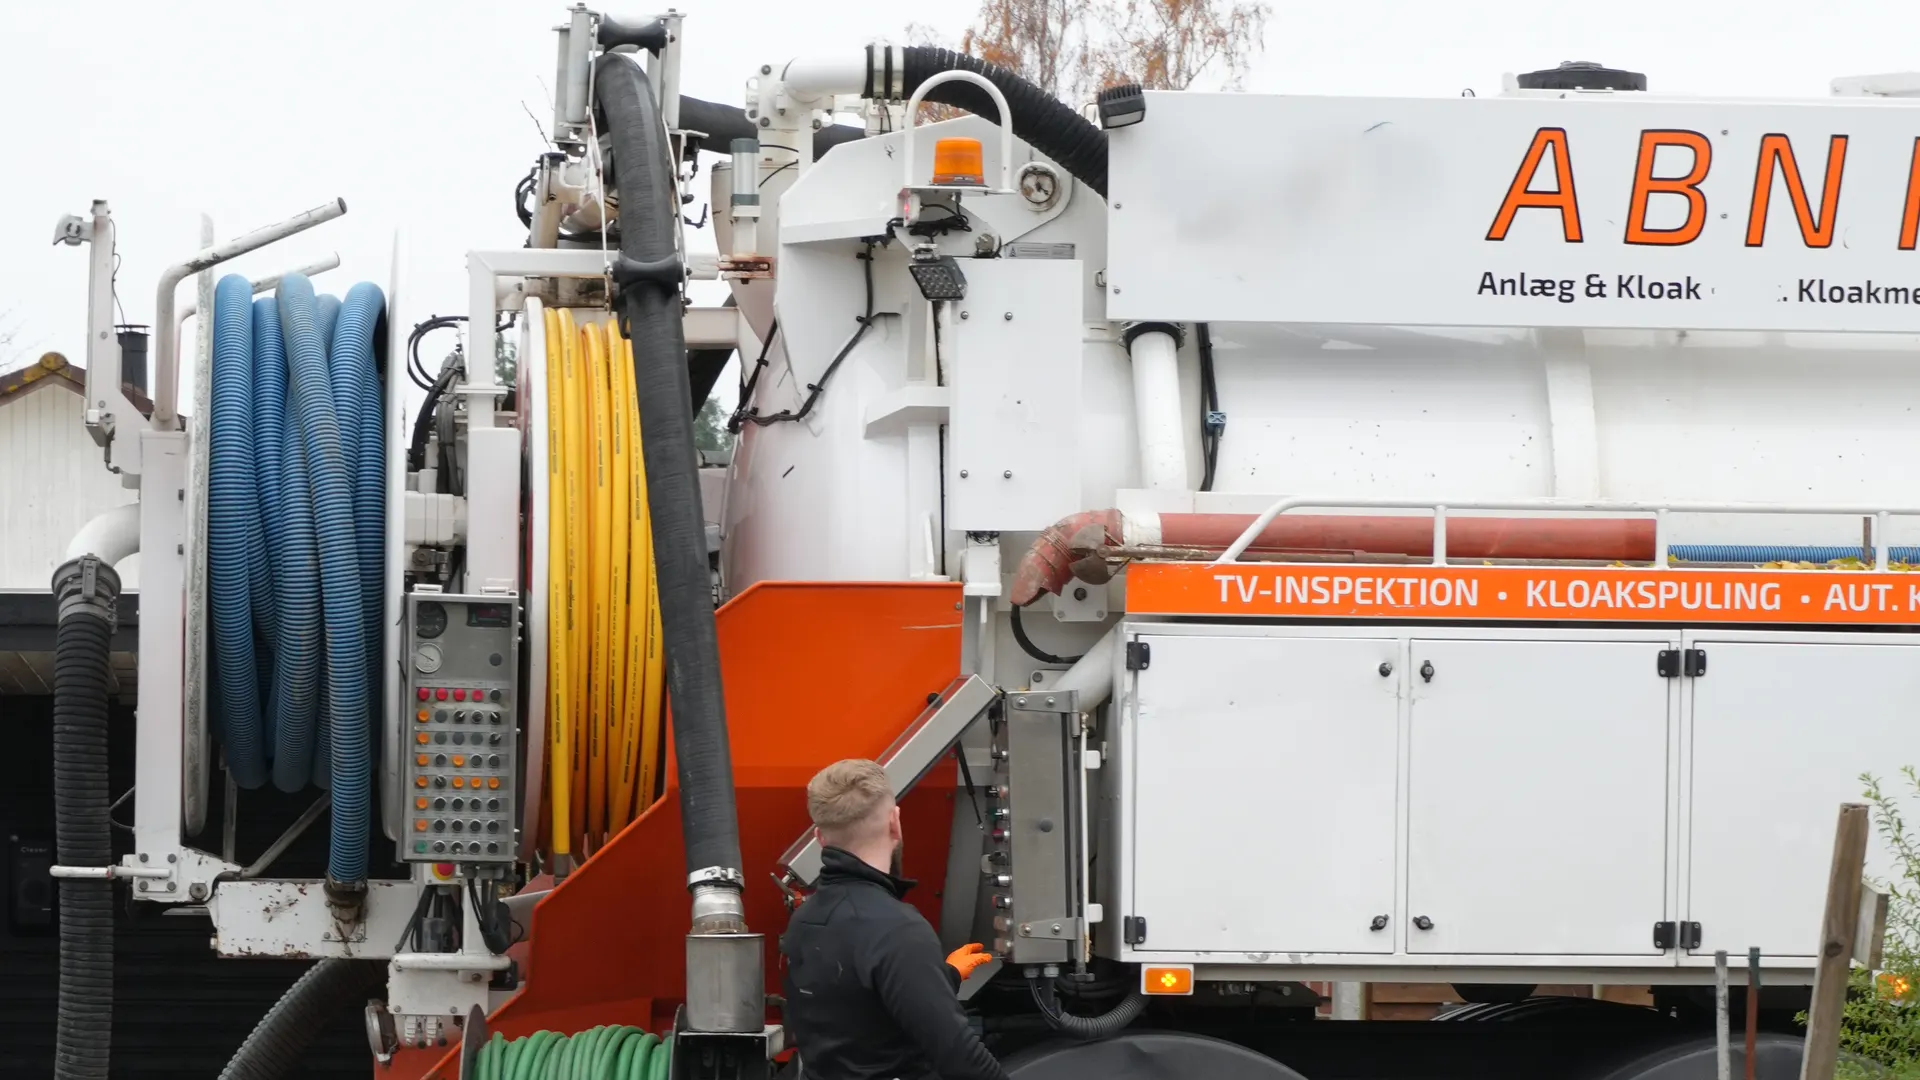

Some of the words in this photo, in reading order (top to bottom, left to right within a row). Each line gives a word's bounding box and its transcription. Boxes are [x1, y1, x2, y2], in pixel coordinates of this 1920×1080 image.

[1484, 126, 1920, 250] ABN
[1477, 271, 1576, 304] Anlæg
[1584, 273, 1607, 299] &
[1617, 274, 1702, 300] Kloak
[1213, 574, 1480, 608] TV-INSPEKTION
[1525, 578, 1782, 613] KLOAKSPULING
[1823, 583, 1899, 612] AUT.
